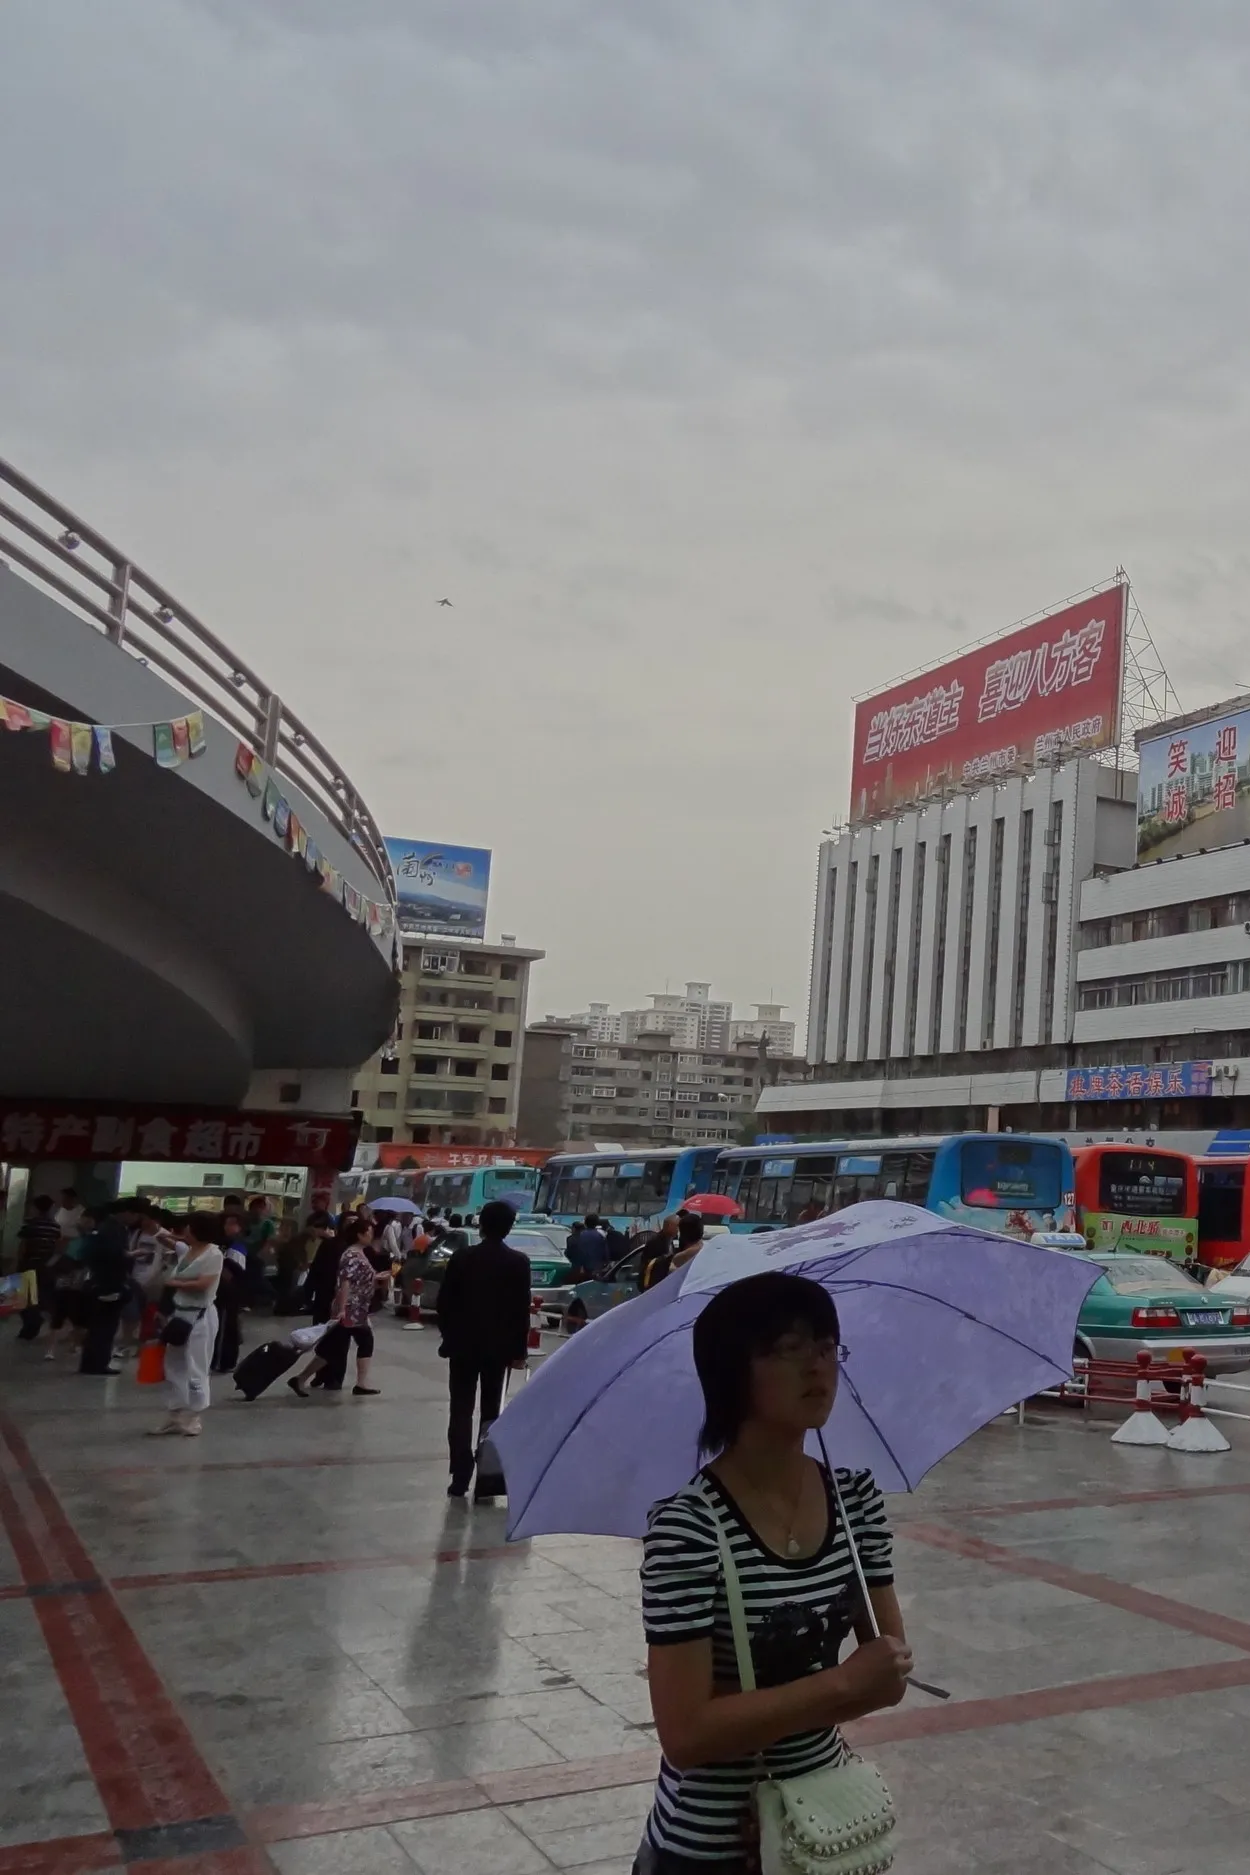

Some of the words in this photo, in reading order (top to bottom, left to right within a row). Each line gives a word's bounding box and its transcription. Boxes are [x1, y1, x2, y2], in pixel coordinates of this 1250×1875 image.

[977, 619, 1106, 723] 喜迎八方客
